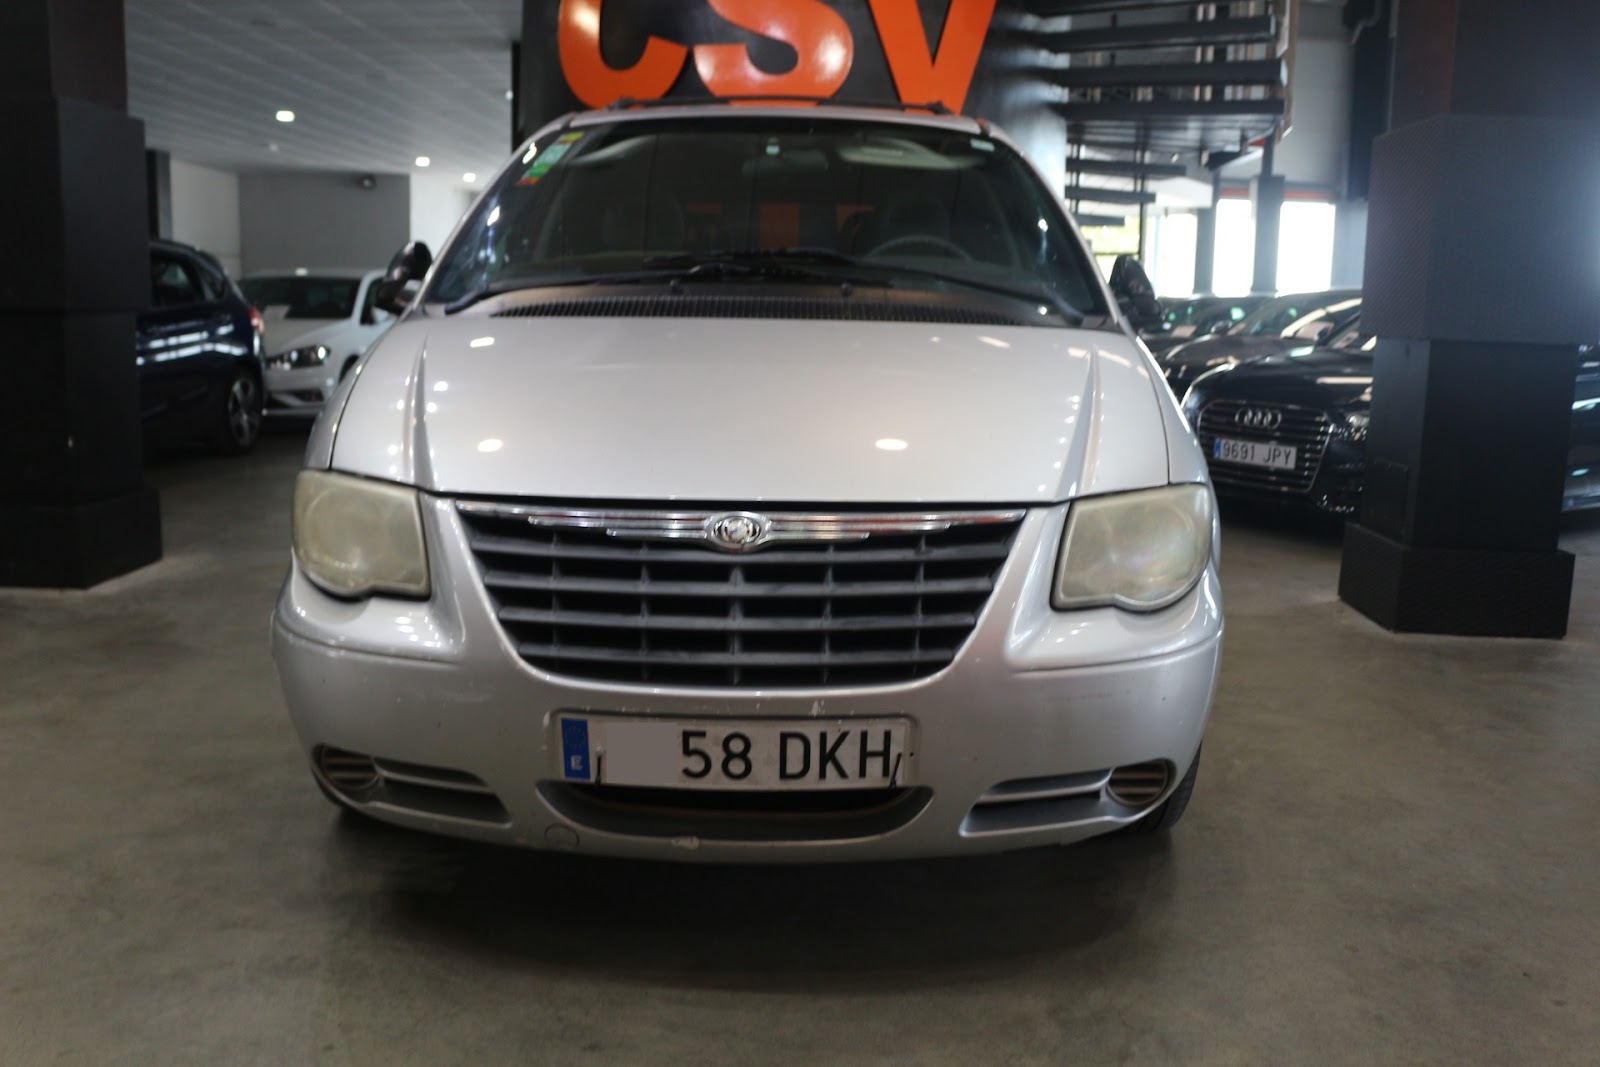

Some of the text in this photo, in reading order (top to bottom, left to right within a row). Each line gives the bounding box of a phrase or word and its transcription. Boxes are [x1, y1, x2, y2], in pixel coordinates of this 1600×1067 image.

[557, 0, 998, 115] CSV
[1222, 442, 1292, 466] 9691 JPY
[778, 729, 892, 781] DKH
